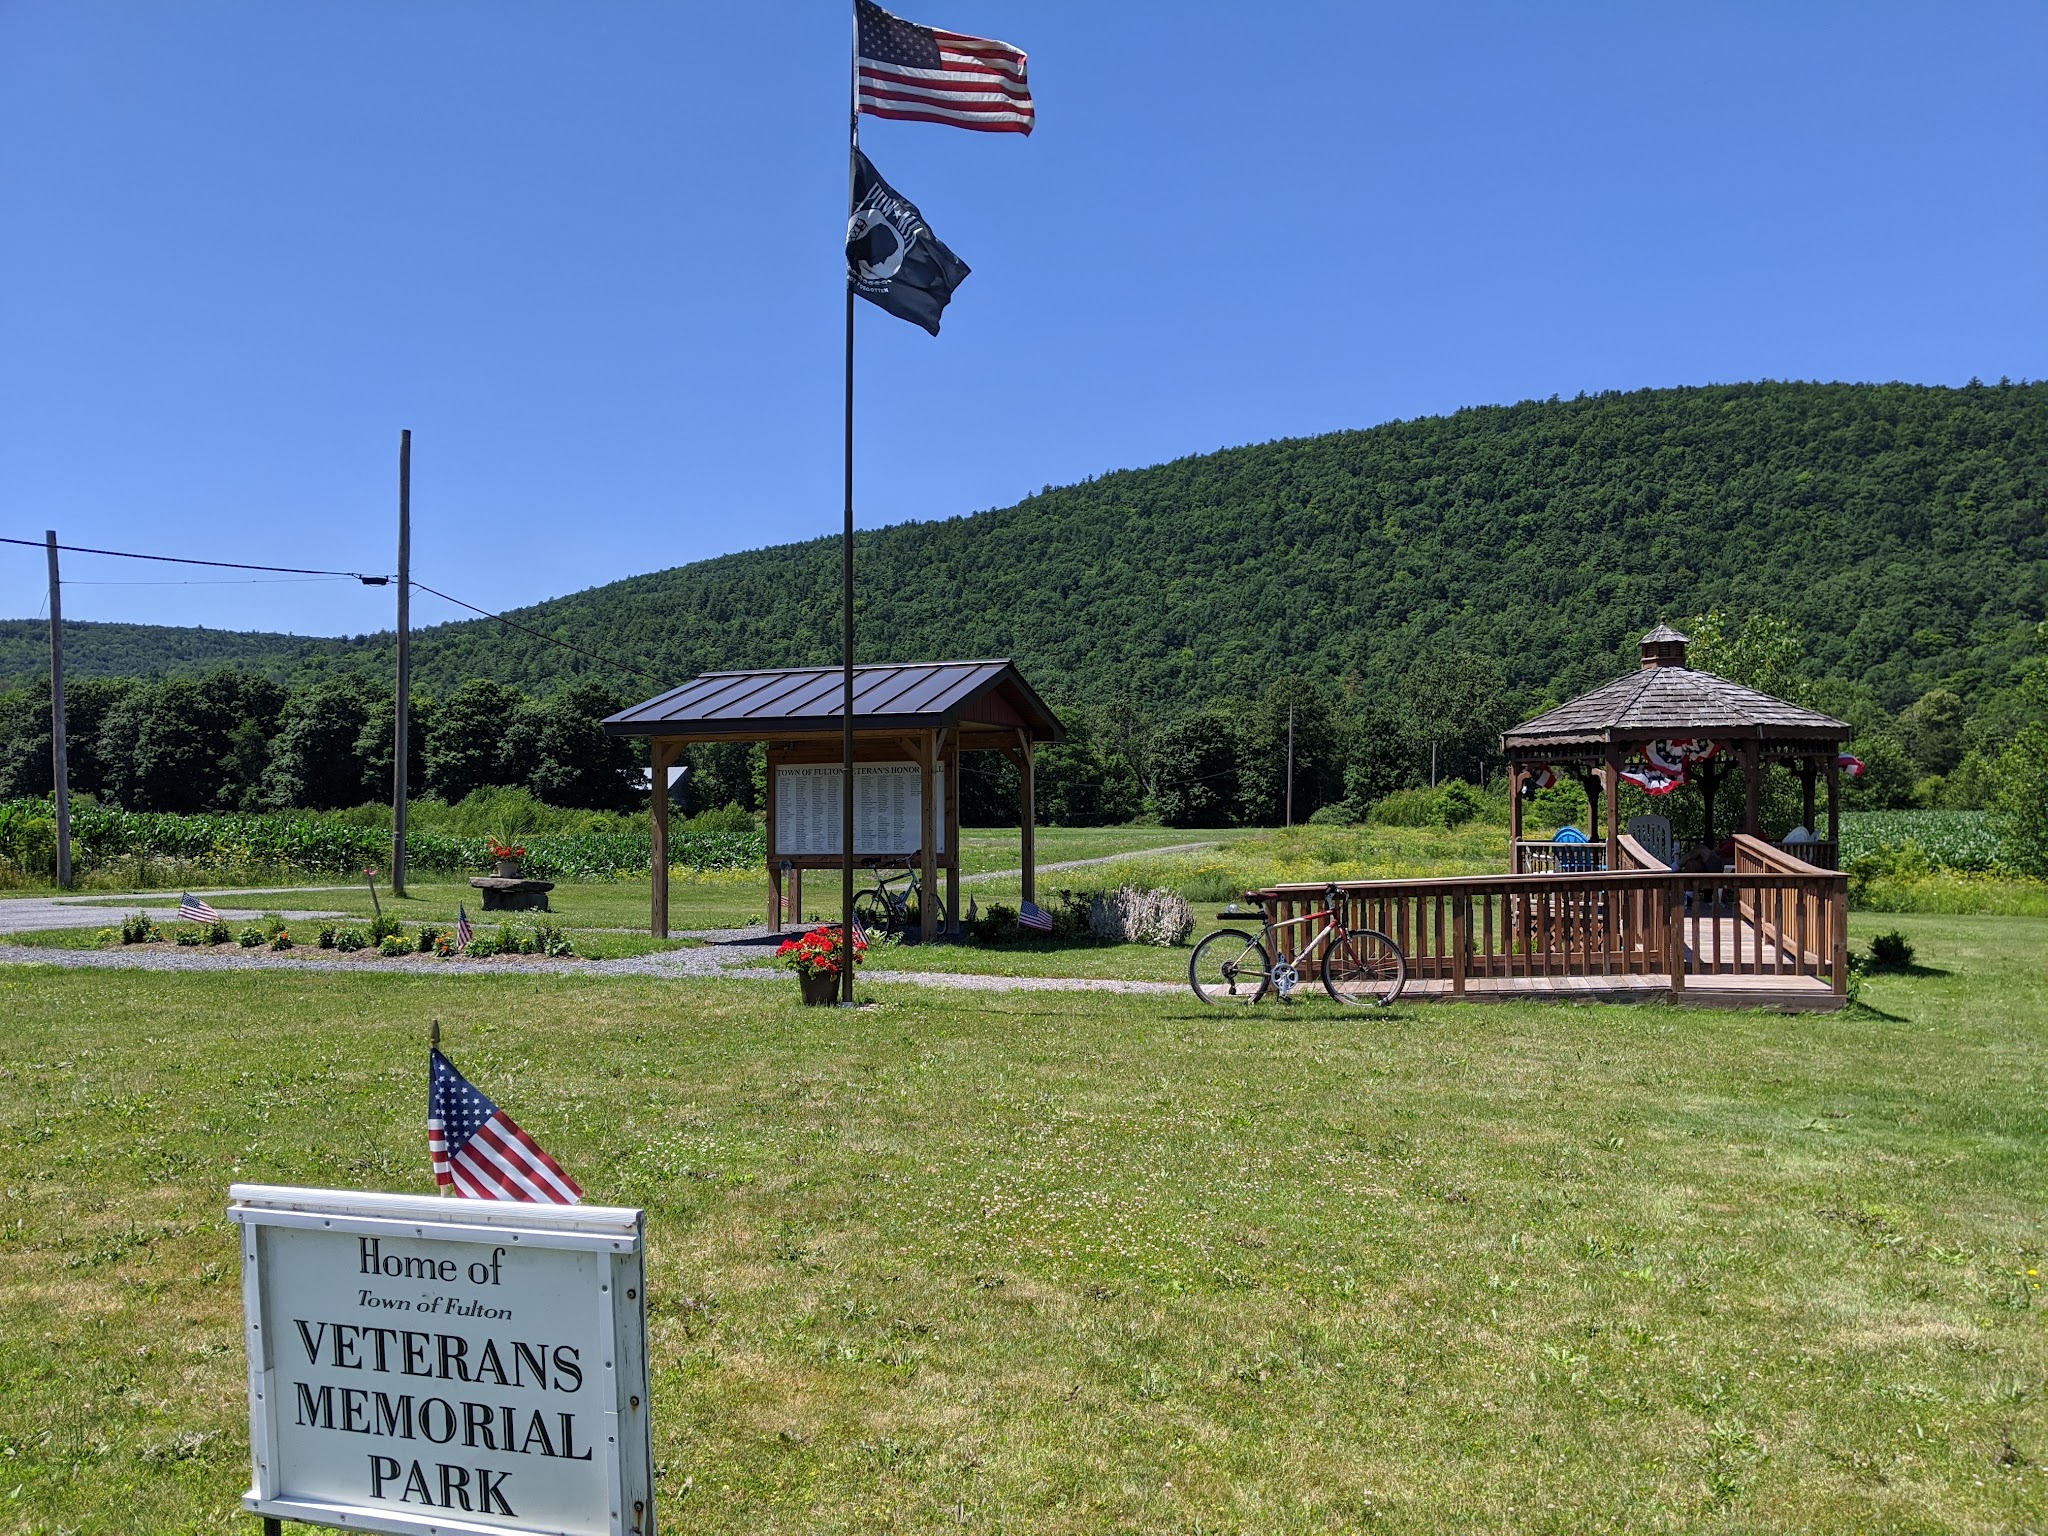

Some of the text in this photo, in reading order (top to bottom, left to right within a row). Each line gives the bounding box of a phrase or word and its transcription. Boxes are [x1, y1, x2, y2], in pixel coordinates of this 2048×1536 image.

[776, 766, 920, 777] TOWN OF FULTON ETERAN'S HONOR
[358, 1236, 506, 1286] Home of
[358, 1289, 513, 1320] Town of Fulton
[293, 1319, 583, 1393] VETERANS
[293, 1382, 593, 1461] MEMORIAL
[367, 1454, 519, 1518] PARK
